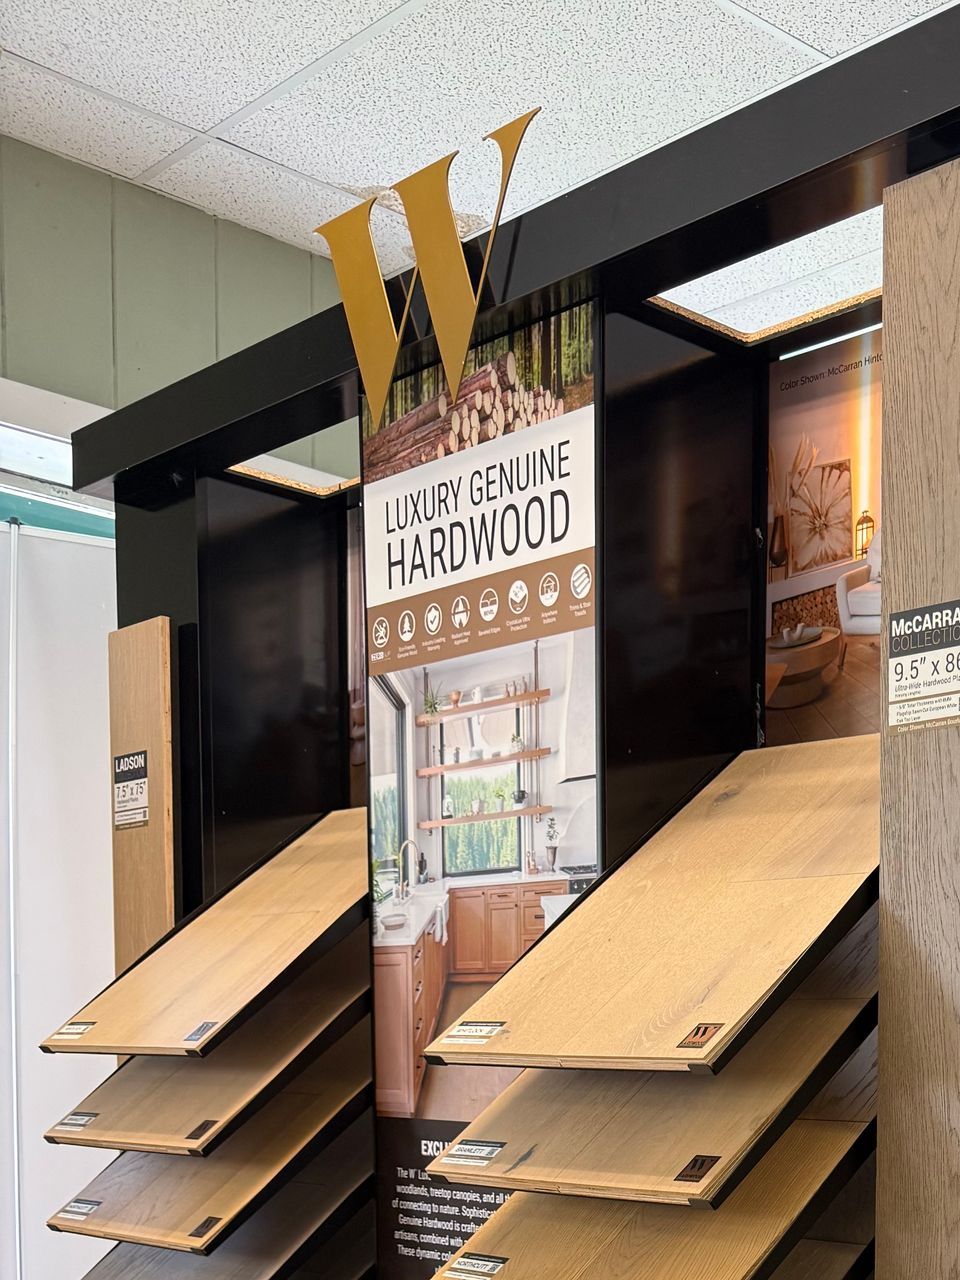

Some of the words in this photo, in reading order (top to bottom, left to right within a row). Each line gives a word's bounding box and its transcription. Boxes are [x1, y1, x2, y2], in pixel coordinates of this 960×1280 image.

[313, 107, 541, 429] W
[780, 379, 798, 391] Color
[827, 360, 862, 377] McCarran
[386, 476, 462, 534] LUXURY
[470, 440, 570, 506] GENUINE
[388, 489, 570, 590] HARDWOOD
[931, 660, 940, 676] x
[922, 677, 951, 688] Hardwood
[115, 754, 145, 773] LADSON
[397, 1167, 408, 1179] The
[396, 1184, 429, 1197] woodlands,
[430, 1187, 451, 1200] treetop
[452, 1189, 482, 1203] canopies,
[483, 1192, 495, 1203] and
[495, 1193, 504, 1204] all
[392, 1198, 399, 1209] of
[399, 1199, 431, 1214] connecting
[439, 1204, 460, 1215] nature.
[399, 1214, 422, 1226] Genuine
[423, 1217, 453, 1231] Hardwood
[394, 1229, 419, 1242] artisans,
[420, 1233, 449, 1246] combined
[450, 1236, 463, 1247] with
[397, 1245, 415, 1256] These
[416, 1247, 441, 1260] dynamic
